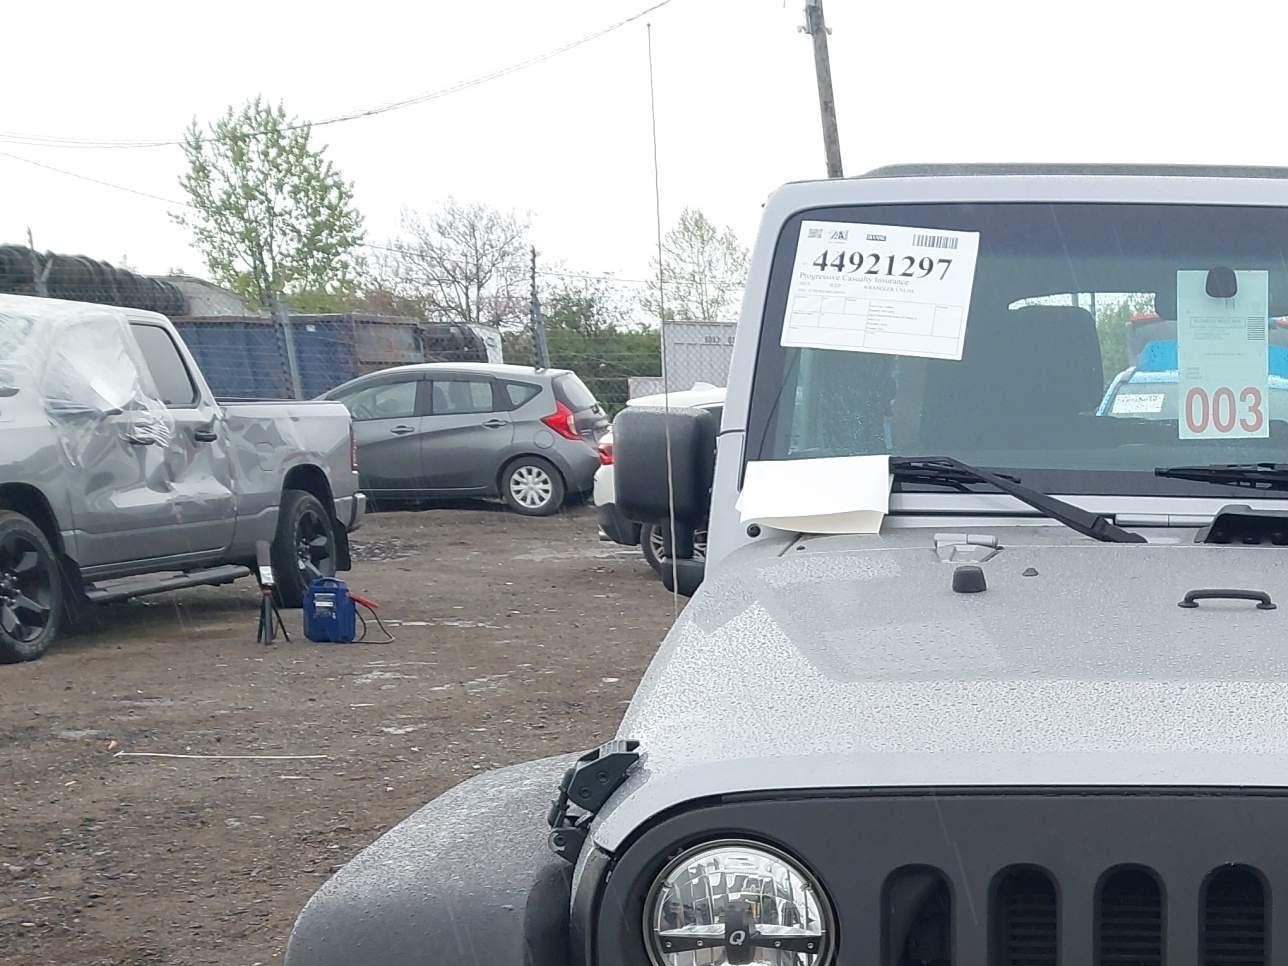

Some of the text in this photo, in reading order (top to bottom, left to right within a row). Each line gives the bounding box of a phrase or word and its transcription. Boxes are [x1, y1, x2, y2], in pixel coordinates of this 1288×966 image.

[799, 271, 910, 286] Progressive Casualty Insurance
[812, 249, 953, 281] 44921297
[1185, 386, 1264, 433] 003
